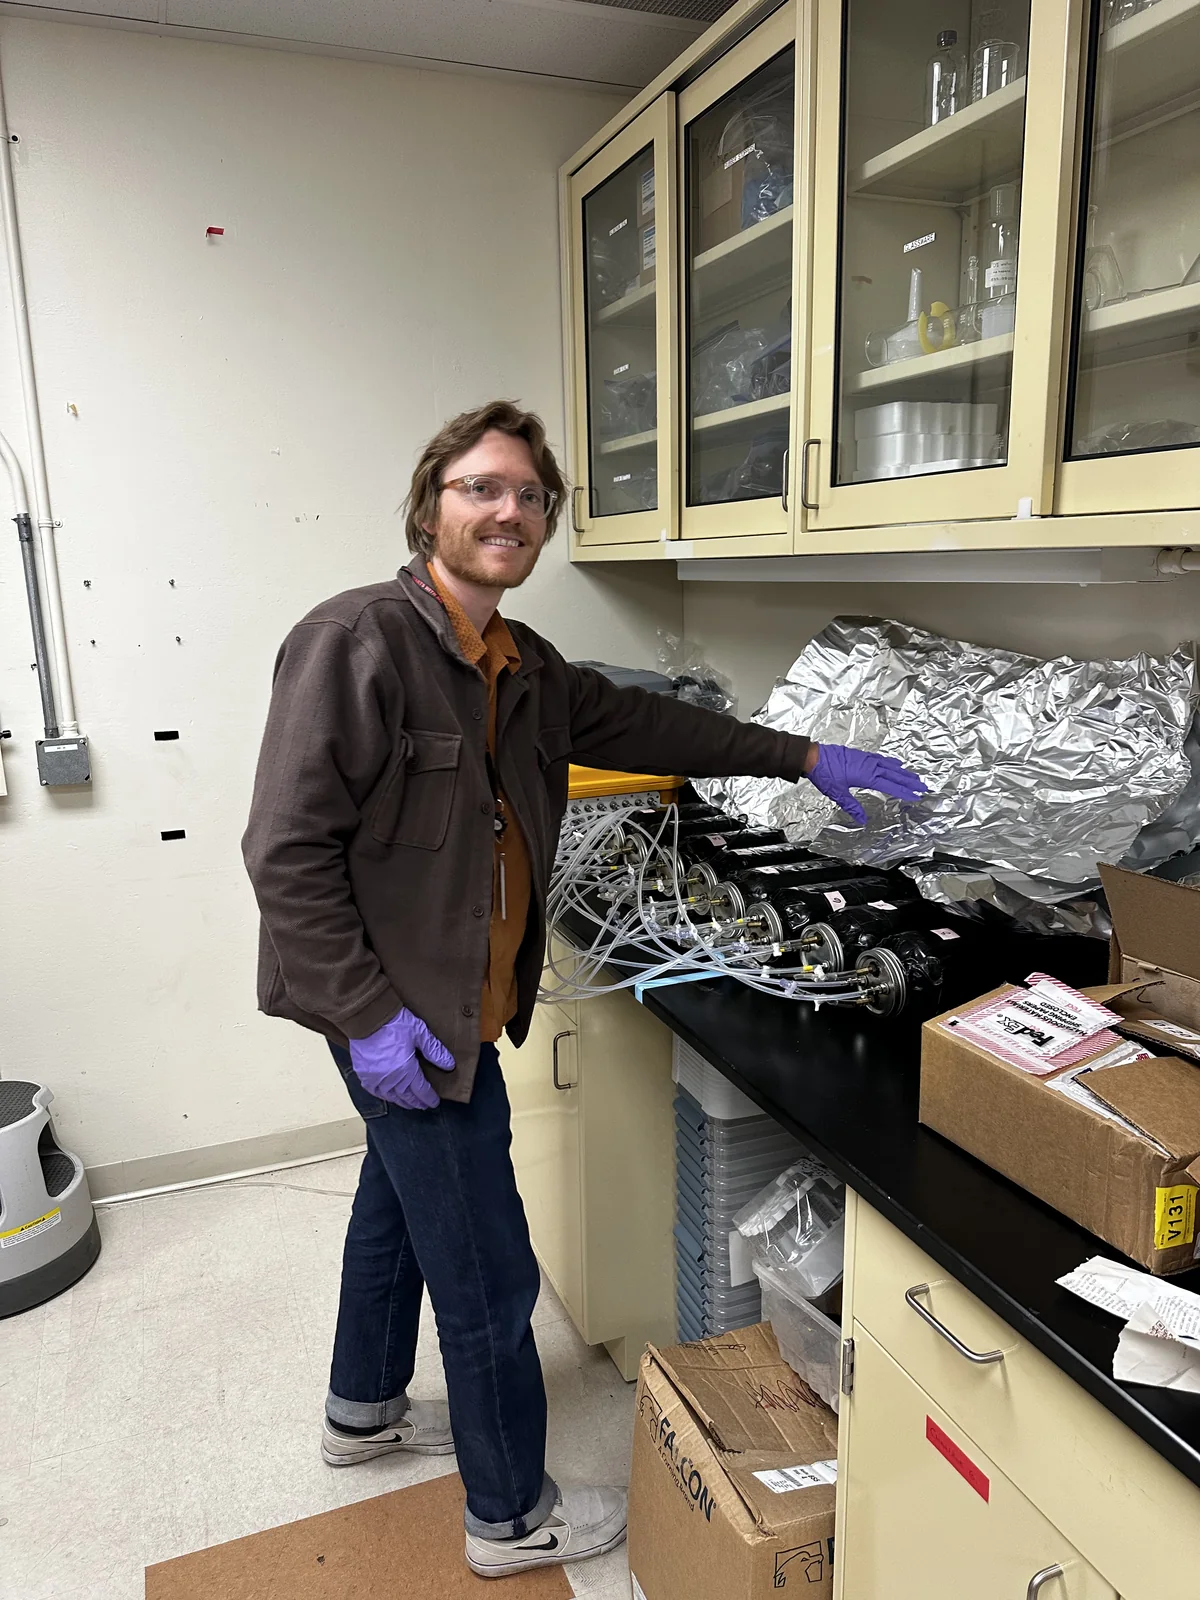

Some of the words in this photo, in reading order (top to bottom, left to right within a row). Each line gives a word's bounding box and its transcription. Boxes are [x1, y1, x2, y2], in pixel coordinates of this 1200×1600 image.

[904, 233, 935, 252] GLASSWARE
[1023, 1000, 1050, 1016] PAPERS
[1040, 1001, 1078, 1021] ENCLOSED
[1041, 1013, 1088, 1036] HAZARDOUS
[1047, 1011, 1082, 1028] SHIPPING
[996, 1016, 1055, 1047] FedEx
[1168, 1195, 1184, 1241] V131
[661, 1452, 680, 1488] Corning
